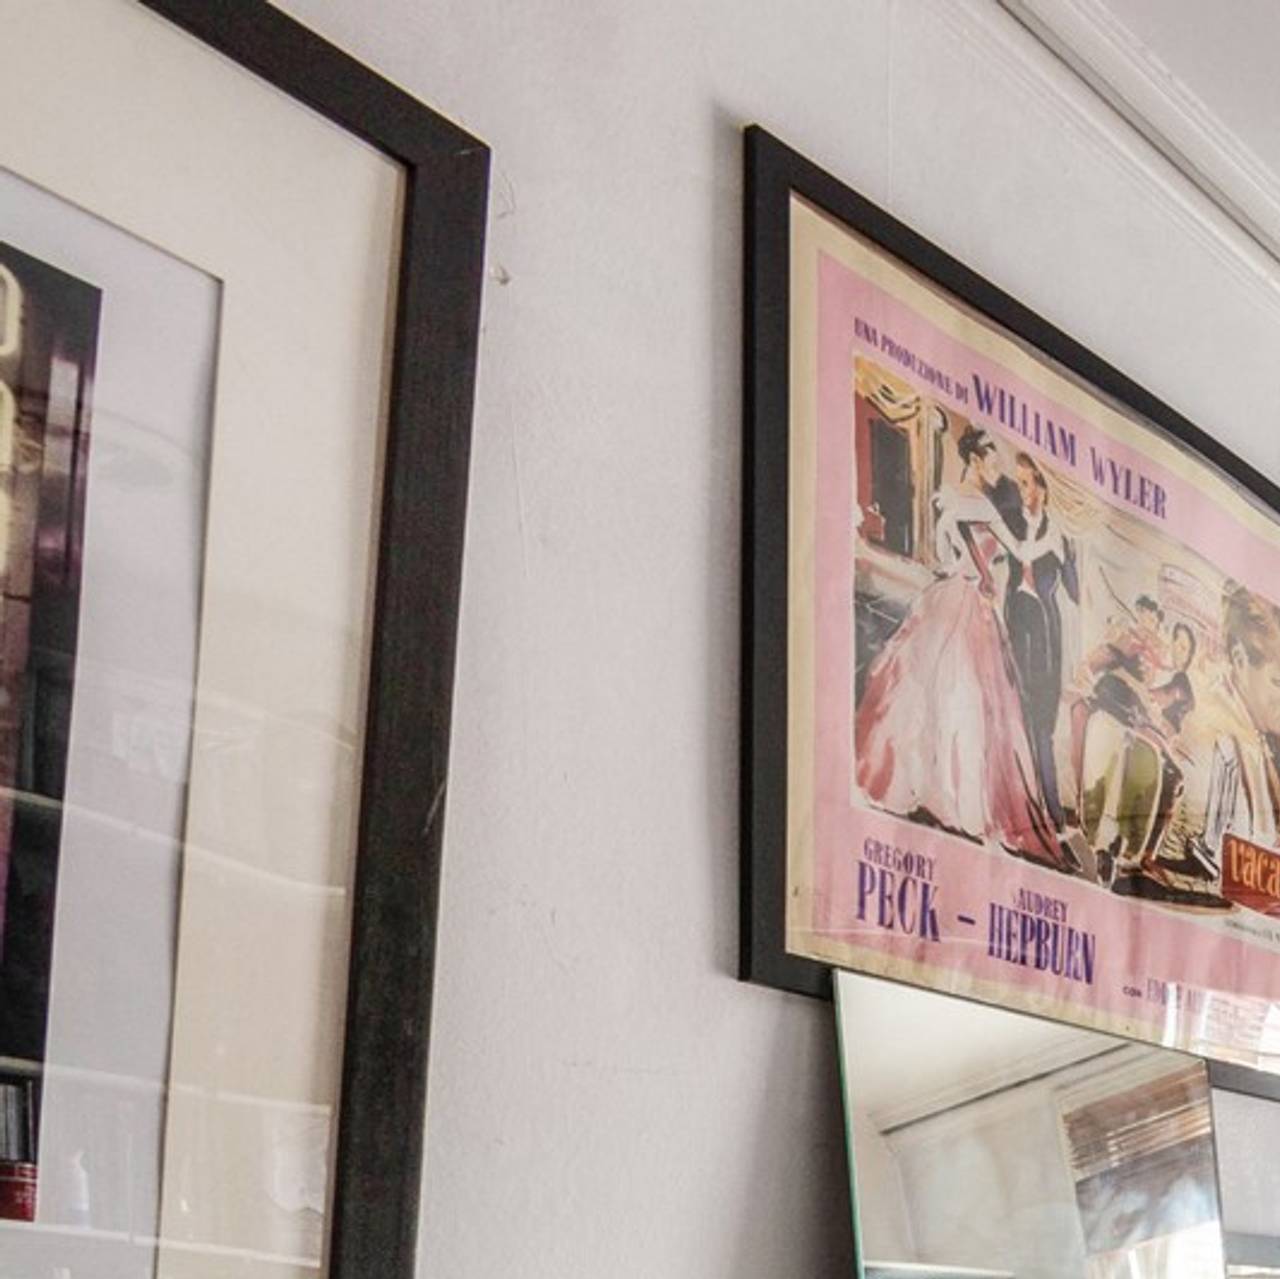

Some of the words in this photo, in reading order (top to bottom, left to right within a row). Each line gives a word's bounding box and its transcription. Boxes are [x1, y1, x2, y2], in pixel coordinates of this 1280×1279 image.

[854, 316, 878, 348] UNA
[881, 333, 954, 396] PRODUZIONE
[955, 381, 969, 405] DI
[971, 373, 1077, 467] WILLIAM
[1090, 446, 1168, 520] WYLER
[863, 837, 936, 883] GREGORY
[856, 861, 941, 942] PECK
[1015, 888, 1069, 923] AUDREY
[987, 902, 1096, 985] HEPBURN
